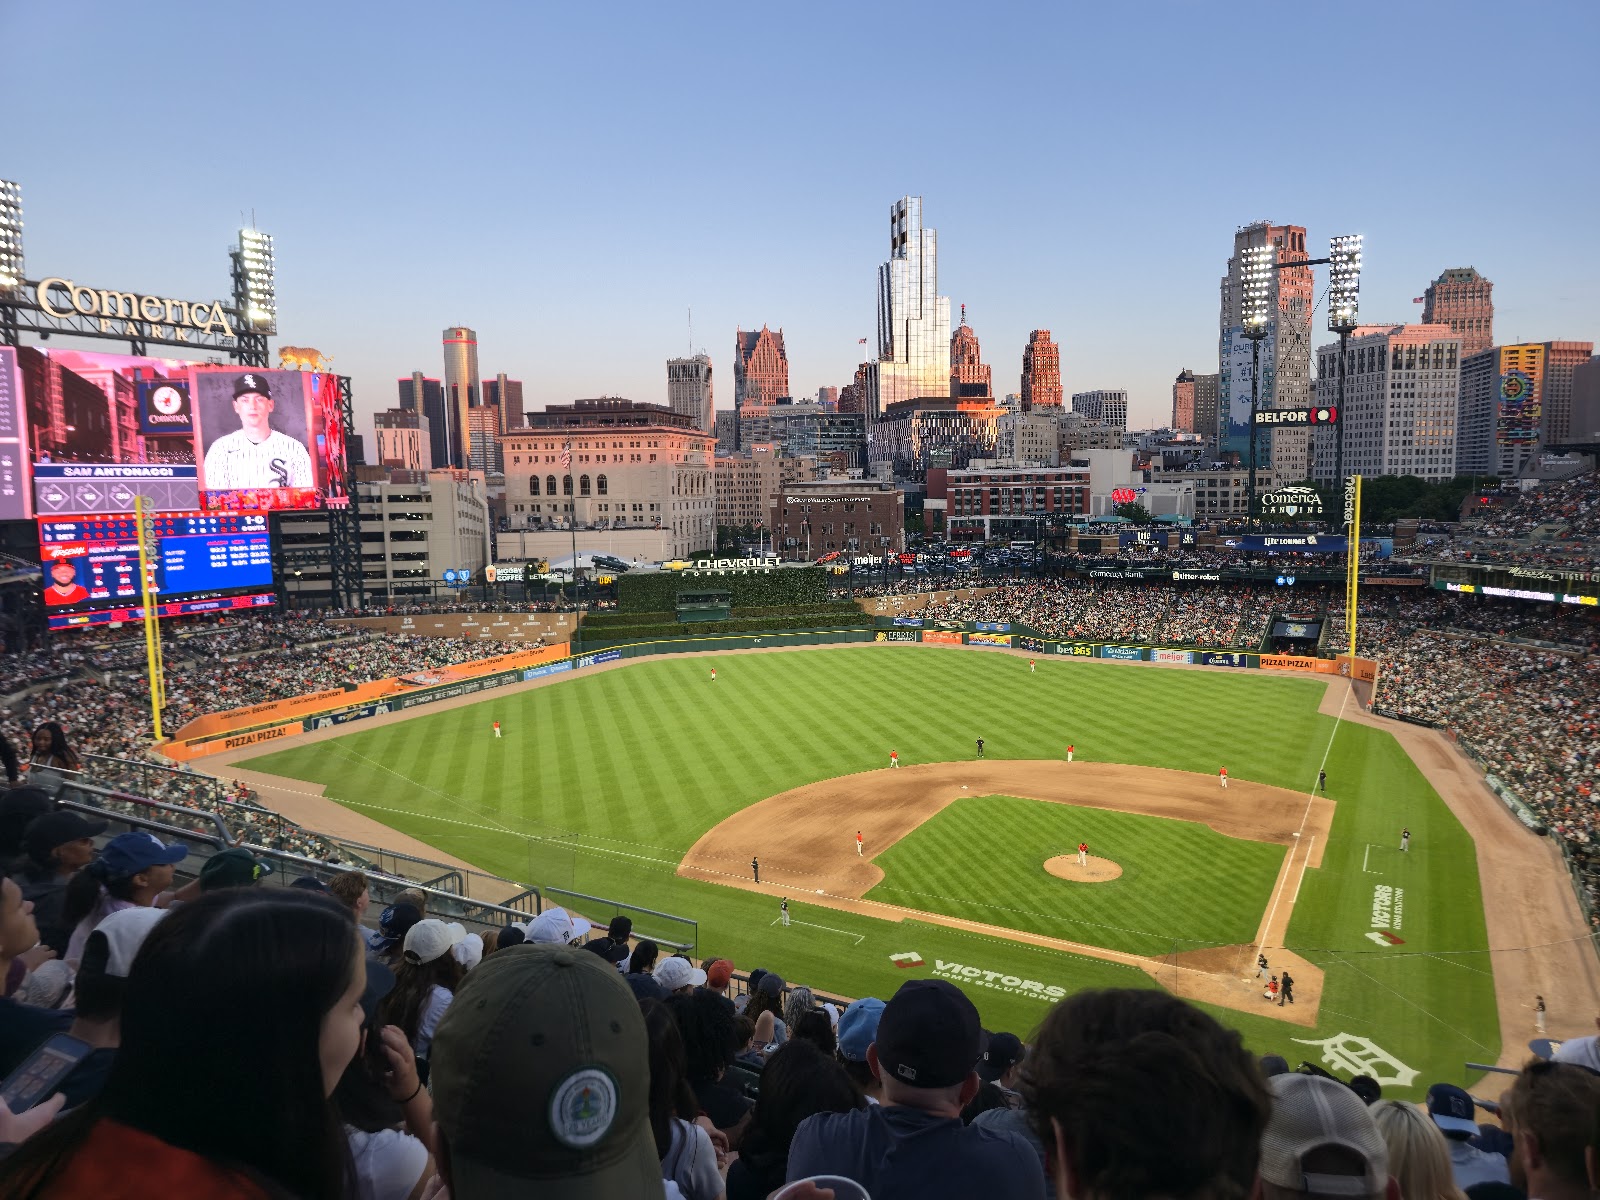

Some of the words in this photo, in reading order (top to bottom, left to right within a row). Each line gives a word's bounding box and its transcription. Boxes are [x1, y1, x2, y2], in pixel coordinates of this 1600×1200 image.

[99, 318, 189, 341] PARK
[1255, 412, 1308, 423] BELFOR
[63, 467, 92, 476] SAM
[94, 467, 173, 476] ANTONACCI
[1261, 493, 1323, 505] Comerica
[244, 515, 265, 525] 1-0
[698, 558, 782, 569] CHEVROLET
[854, 553, 883, 566] meijer
[497, 567, 523, 575] BIGGBY
[1560, 572, 1584, 581] TIGER
[1563, 593, 1598, 605] bet365
[1056, 644, 1091, 656] bet365
[1159, 653, 1184, 661] meijer
[1261, 657, 1286, 667] PIZZA!
[1287, 660, 1313, 669] PIZZA!
[257, 727, 287, 742] PIZZA!
[225, 735, 256, 748] PIZZA!
[935, 960, 1066, 997] VICTORS
[931, 969, 972, 983] HOME
[975, 980, 1060, 1003] SOLUTIONS
